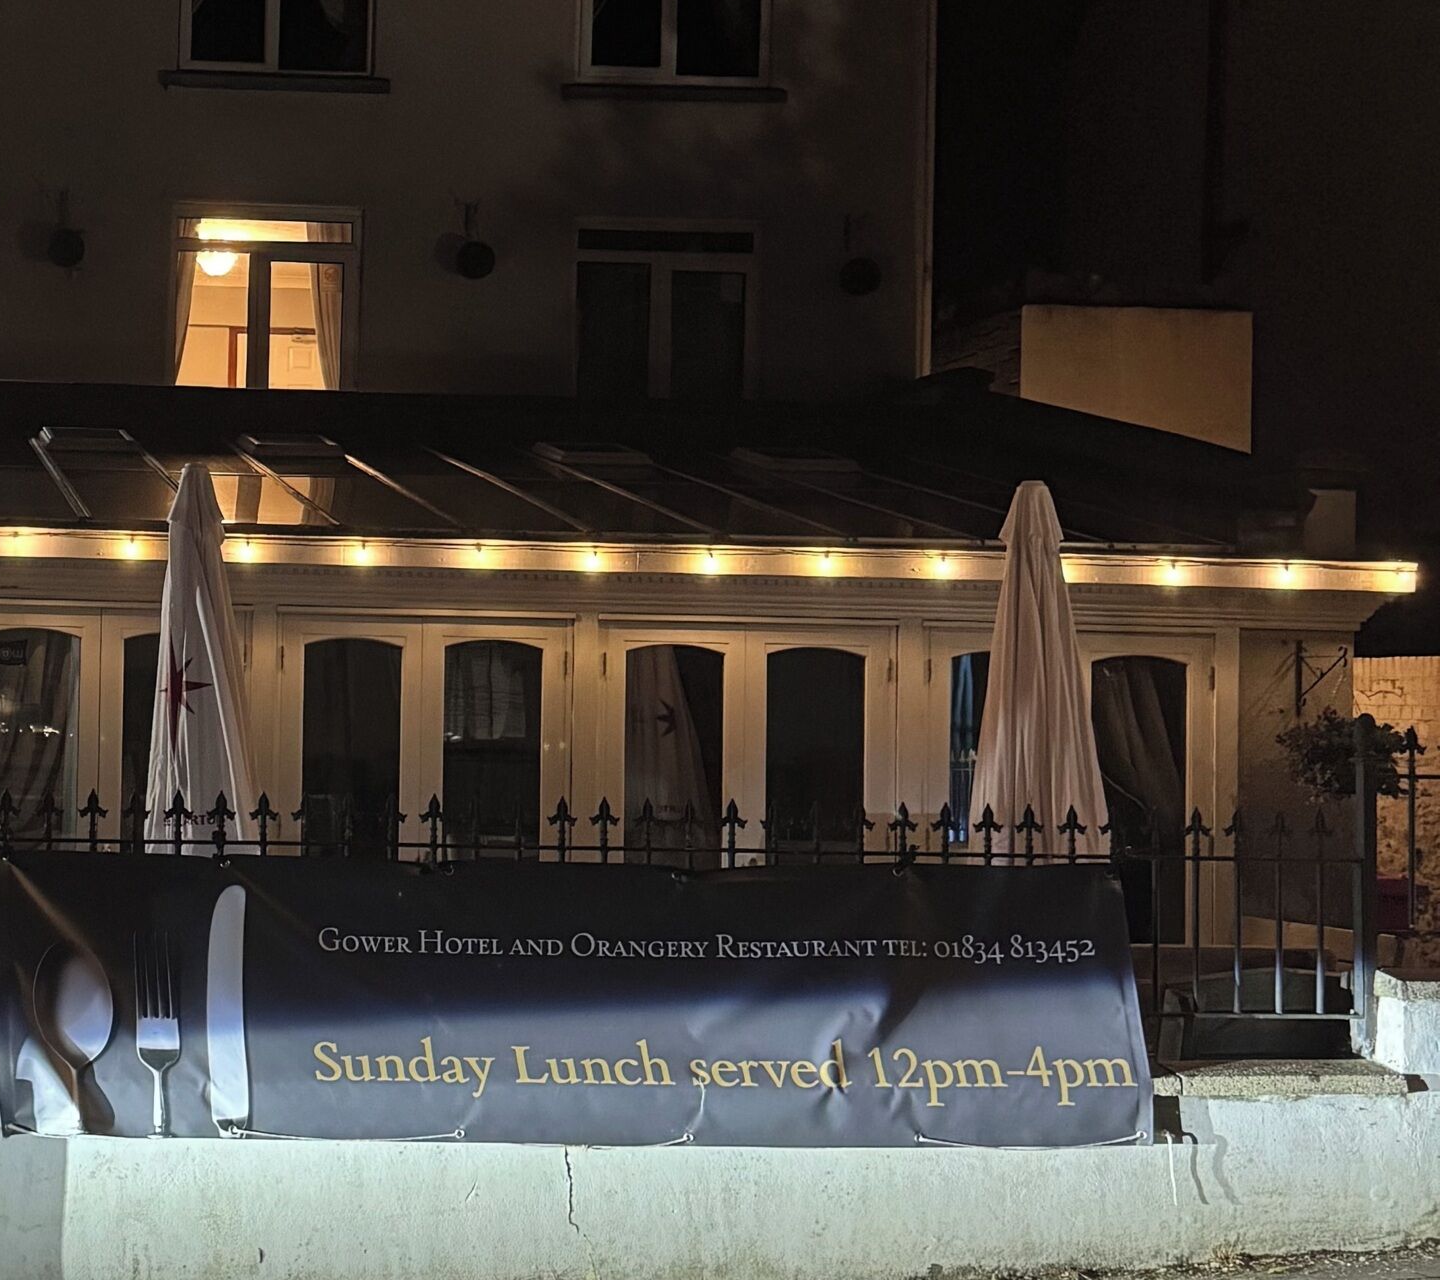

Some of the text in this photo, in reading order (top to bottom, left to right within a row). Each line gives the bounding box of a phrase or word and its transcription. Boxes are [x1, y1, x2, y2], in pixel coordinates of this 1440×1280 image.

[317, 926, 413, 954] GOWER
[417, 929, 504, 956] HOTEL
[508, 938, 564, 957] AND
[570, 932, 709, 960] ORANGERY
[715, 933, 878, 960] RESTAURANT
[933, 934, 1005, 966] 01834
[1009, 933, 1096, 964] 813452
[312, 1036, 1138, 1108] Sunday Lunch served 12pm-4pm
